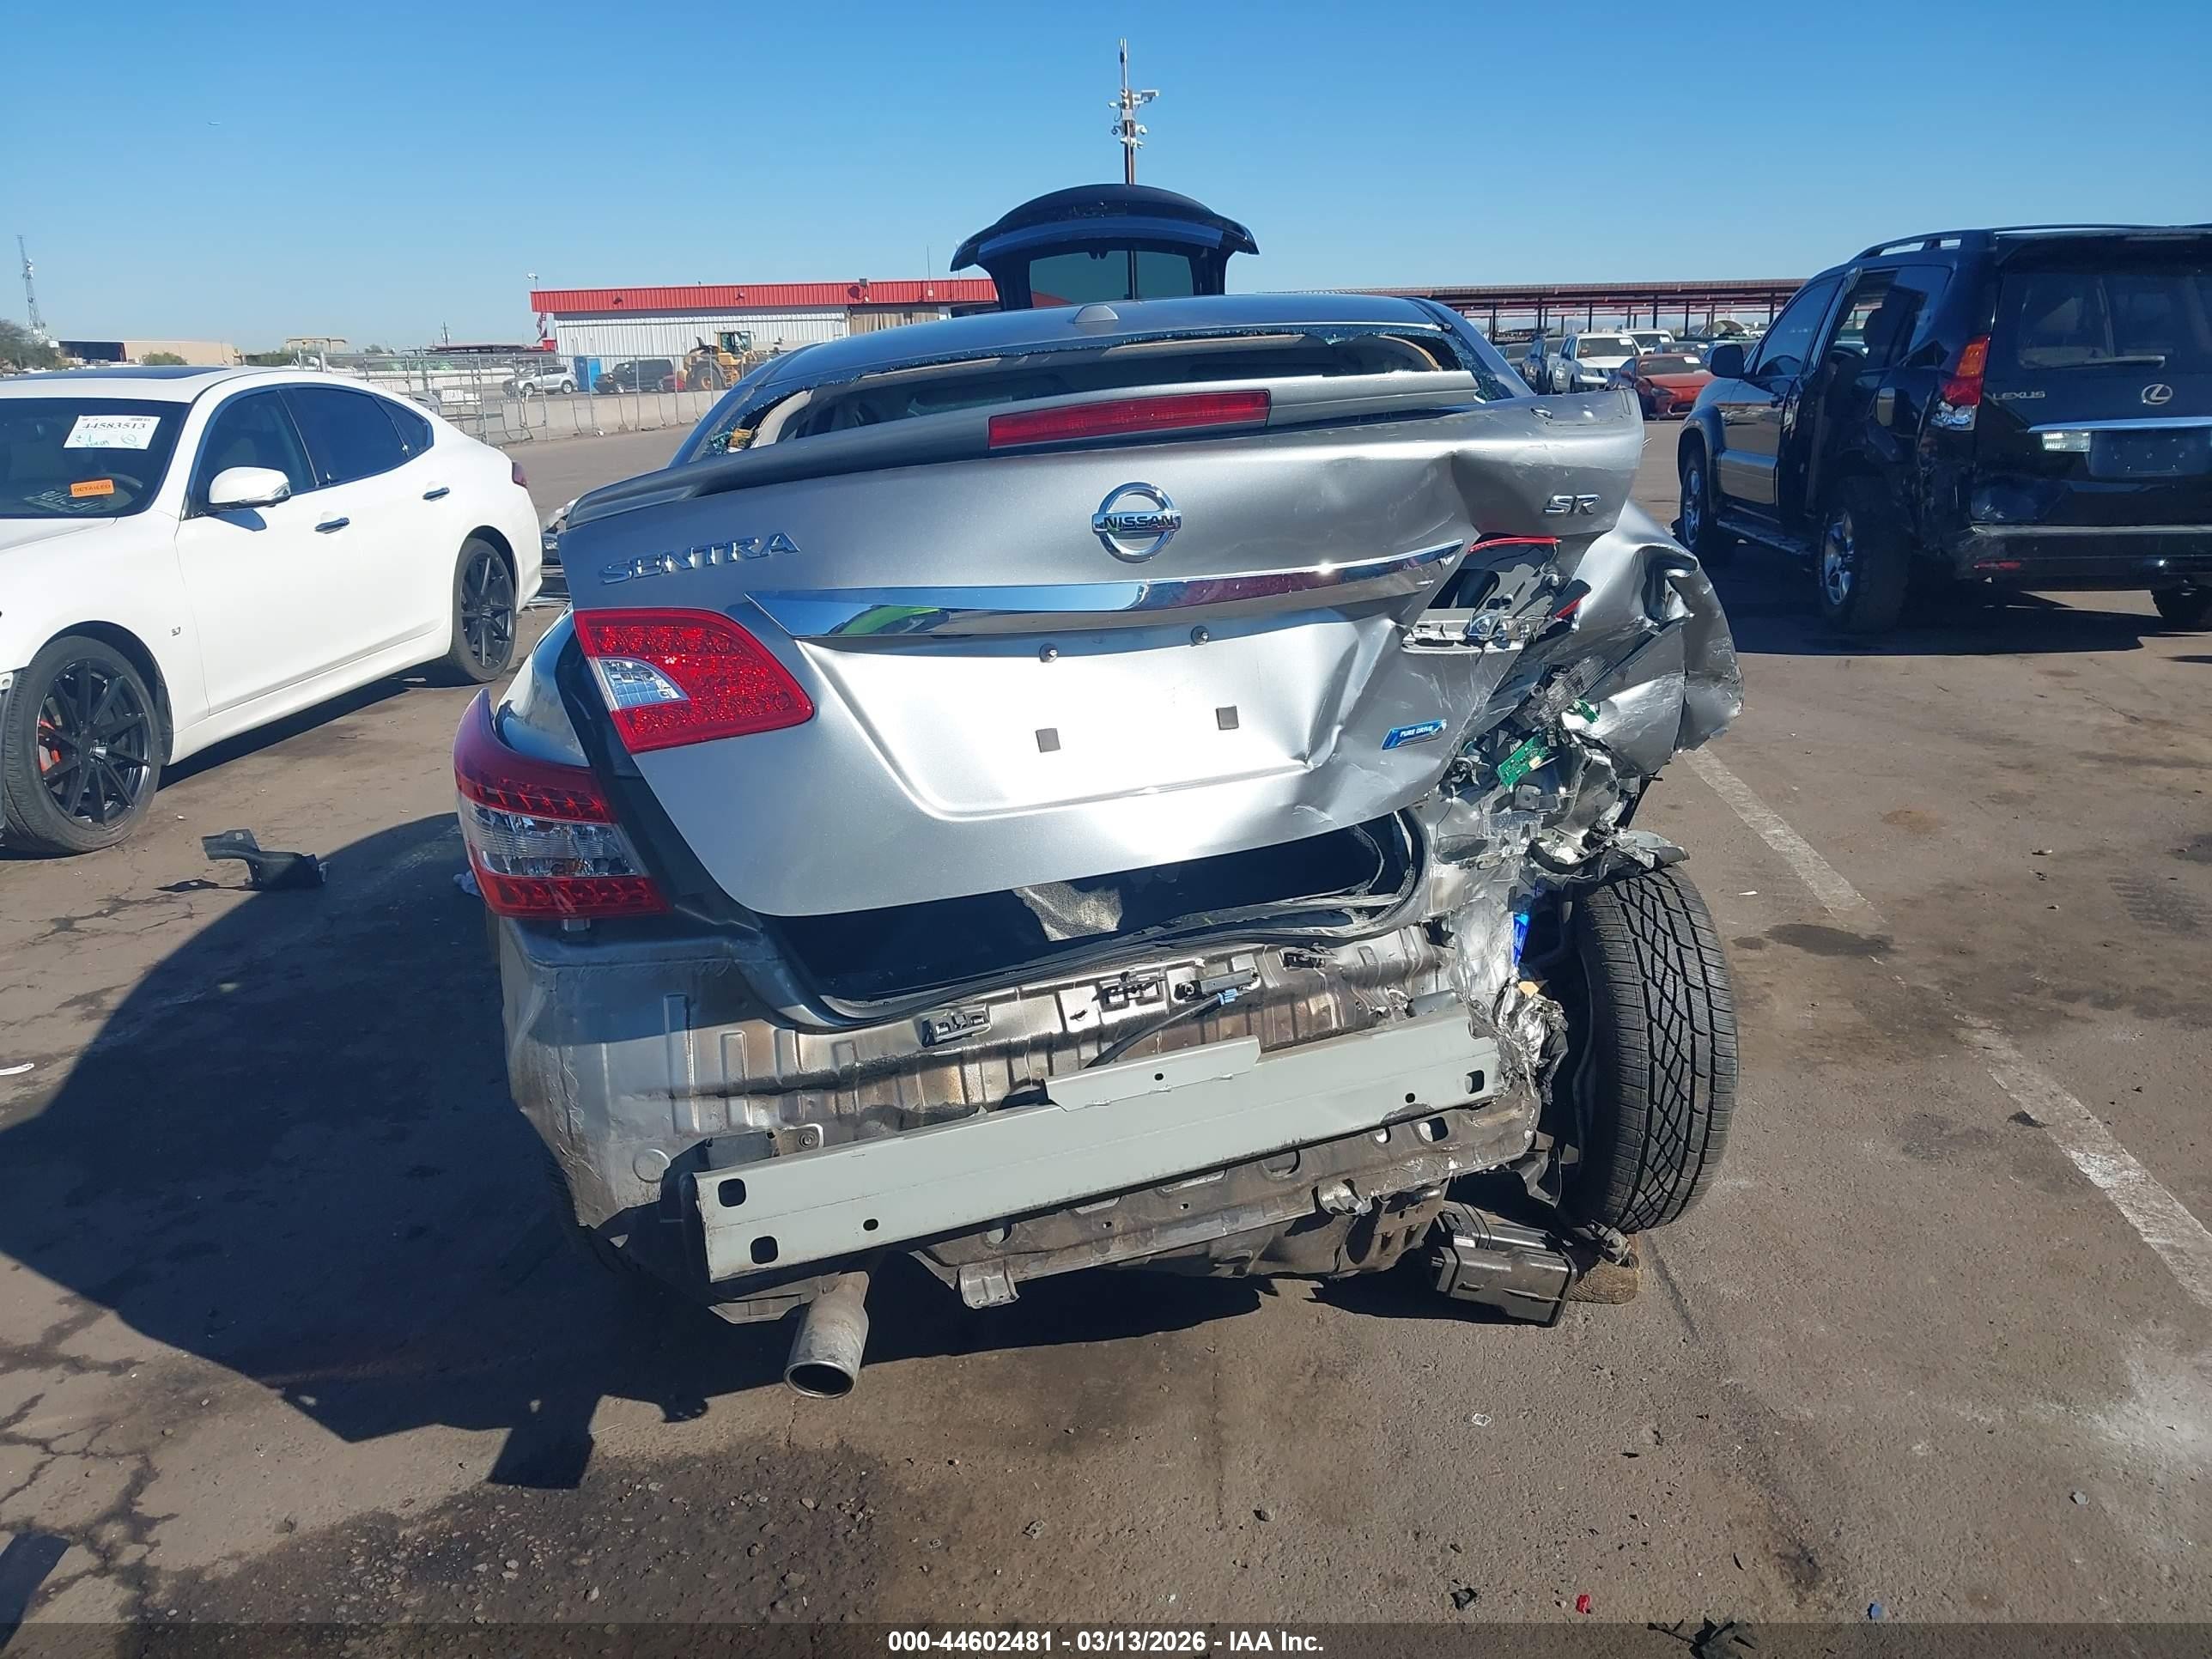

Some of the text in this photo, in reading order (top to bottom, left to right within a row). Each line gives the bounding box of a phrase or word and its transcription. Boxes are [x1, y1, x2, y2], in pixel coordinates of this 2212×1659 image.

[1543, 494, 1601, 515] SR
[1103, 515, 1175, 529] NISSAN
[601, 532, 800, 585] SENTRA
